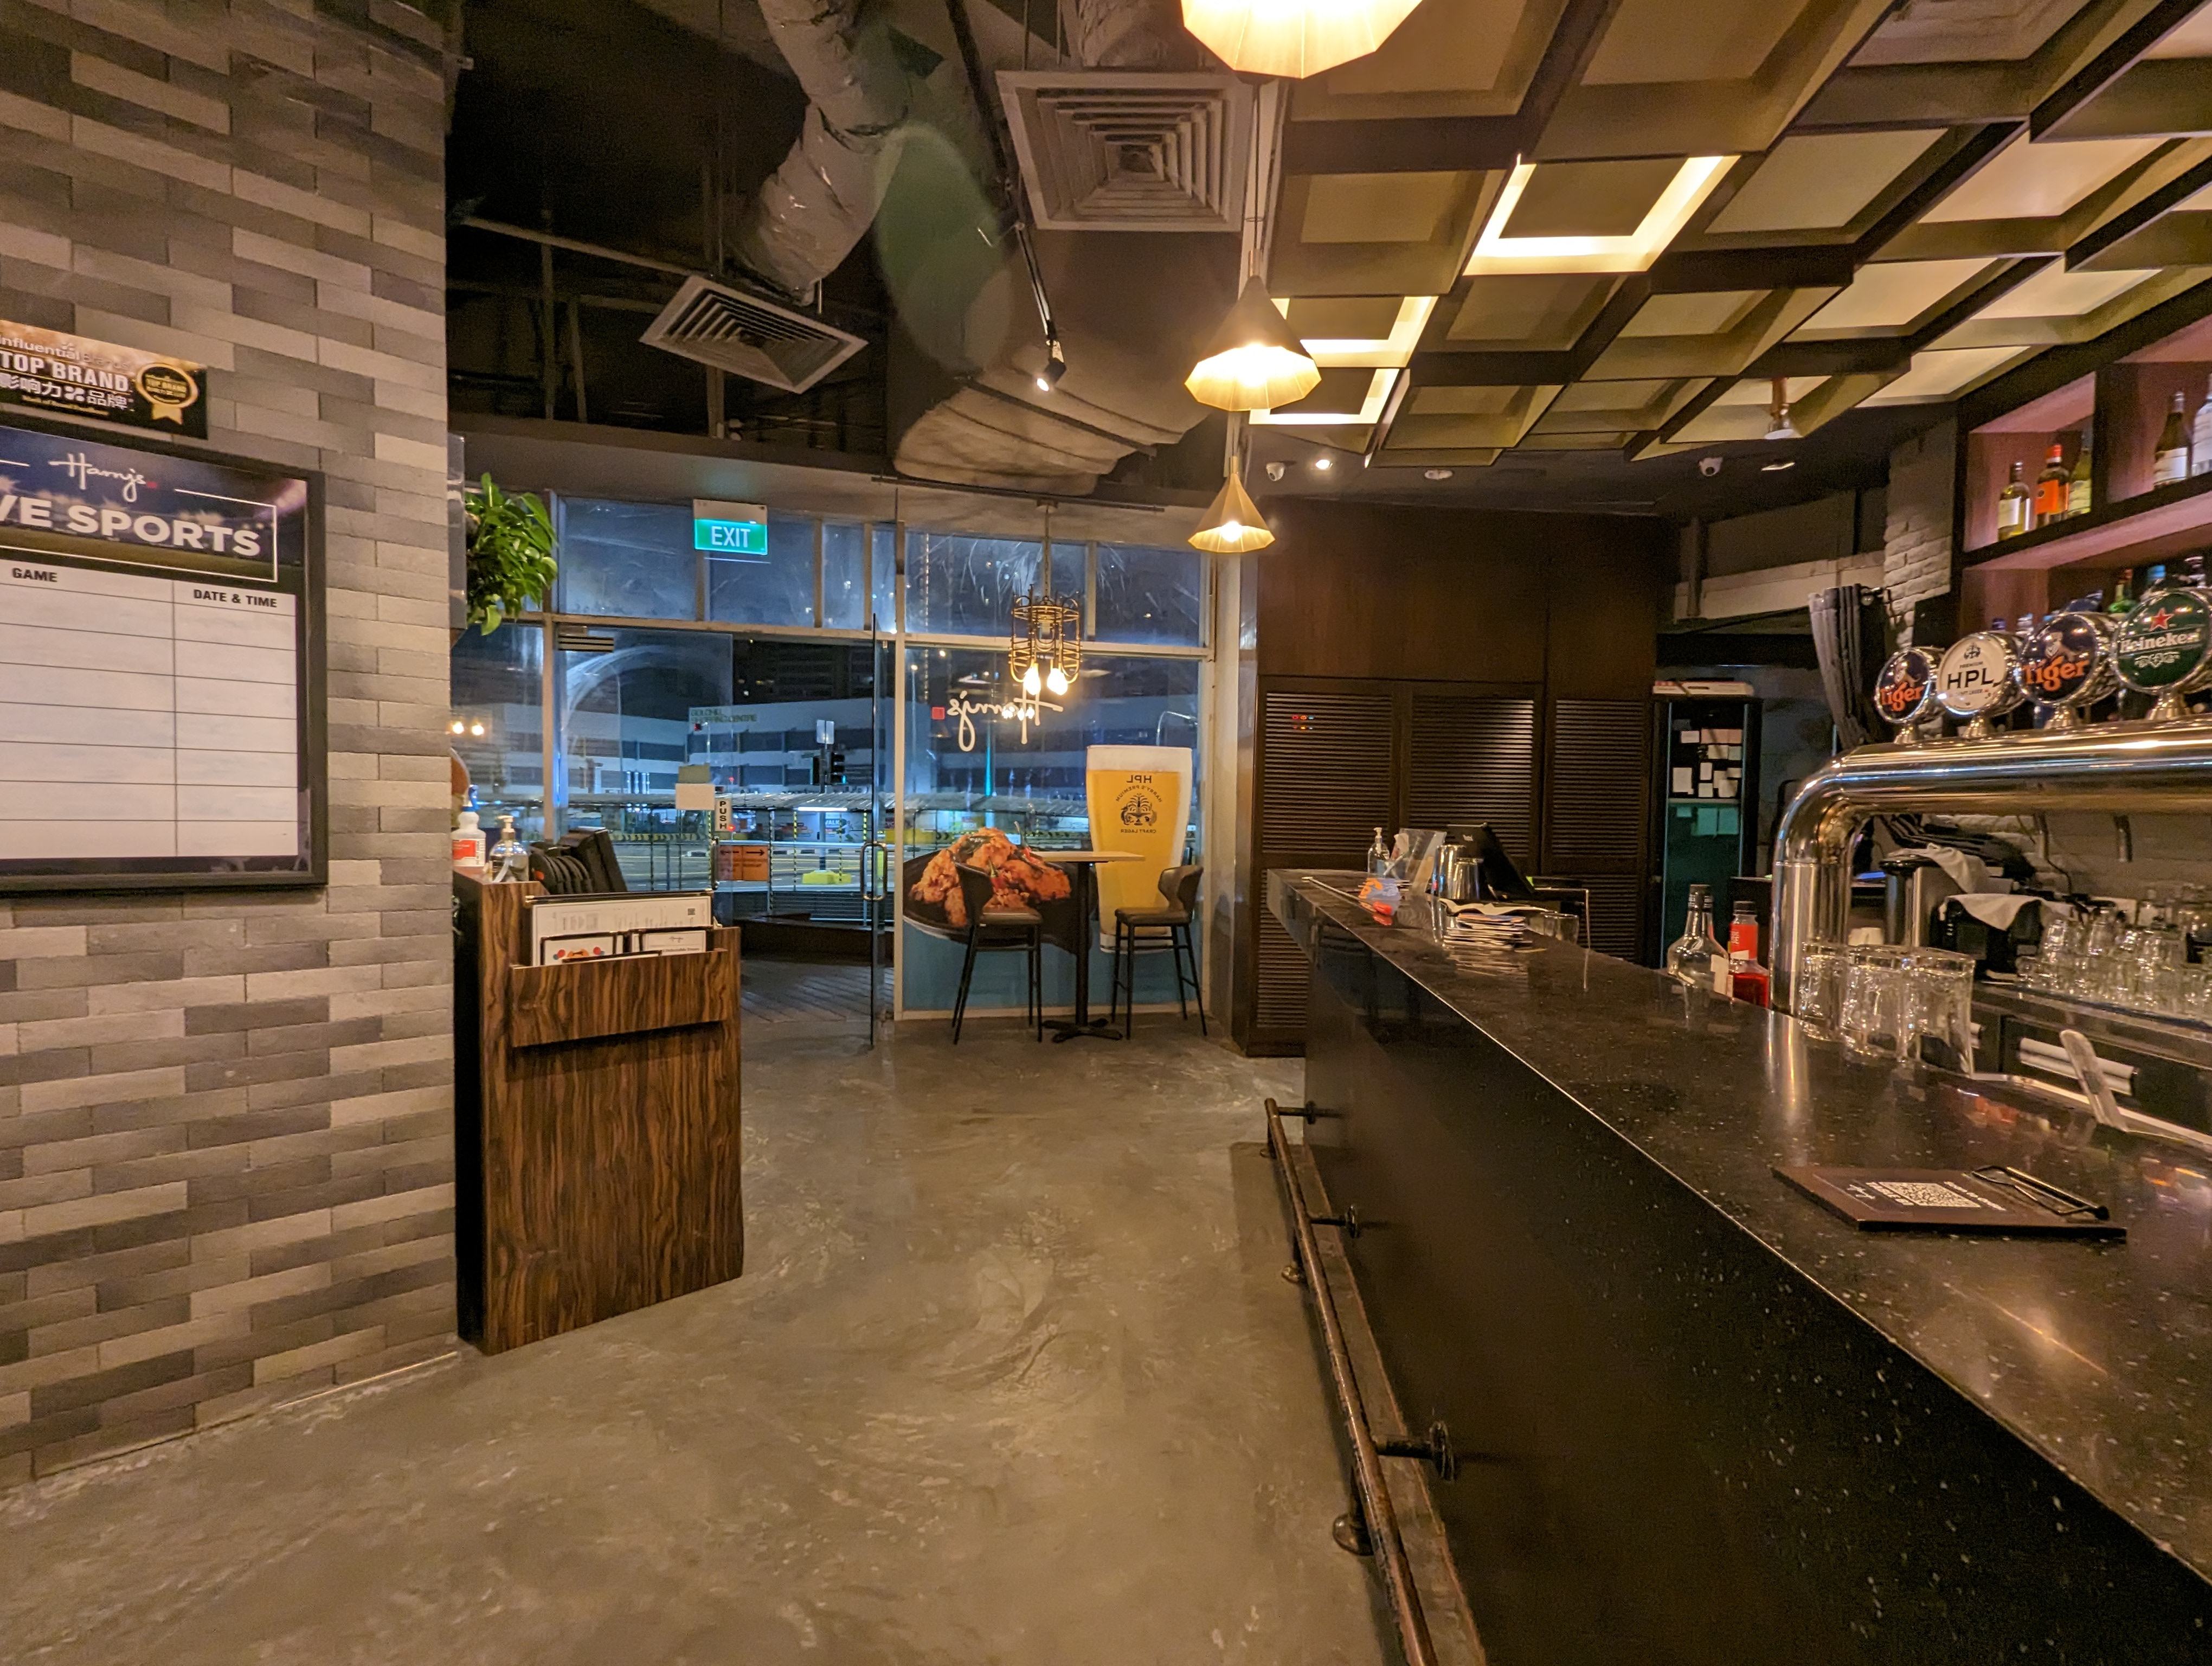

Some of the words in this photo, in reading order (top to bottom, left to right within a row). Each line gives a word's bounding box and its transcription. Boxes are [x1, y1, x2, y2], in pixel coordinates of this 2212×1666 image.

[0, 335, 80, 360] nfluential
[0, 350, 45, 374] TOP
[53, 361, 129, 392] BRAND
[67, 505, 261, 556] SPORTS
[711, 526, 751, 548] EXIT
[12, 568, 57, 582] GAME
[194, 589, 227, 602] DATE
[232, 594, 241, 604] &
[246, 595, 277, 607] TIME
[1947, 668, 1994, 690] HPL
[2023, 656, 2090, 691] Tiger
[1880, 682, 1924, 712] Tiger
[719, 800, 728, 829] PUSH
